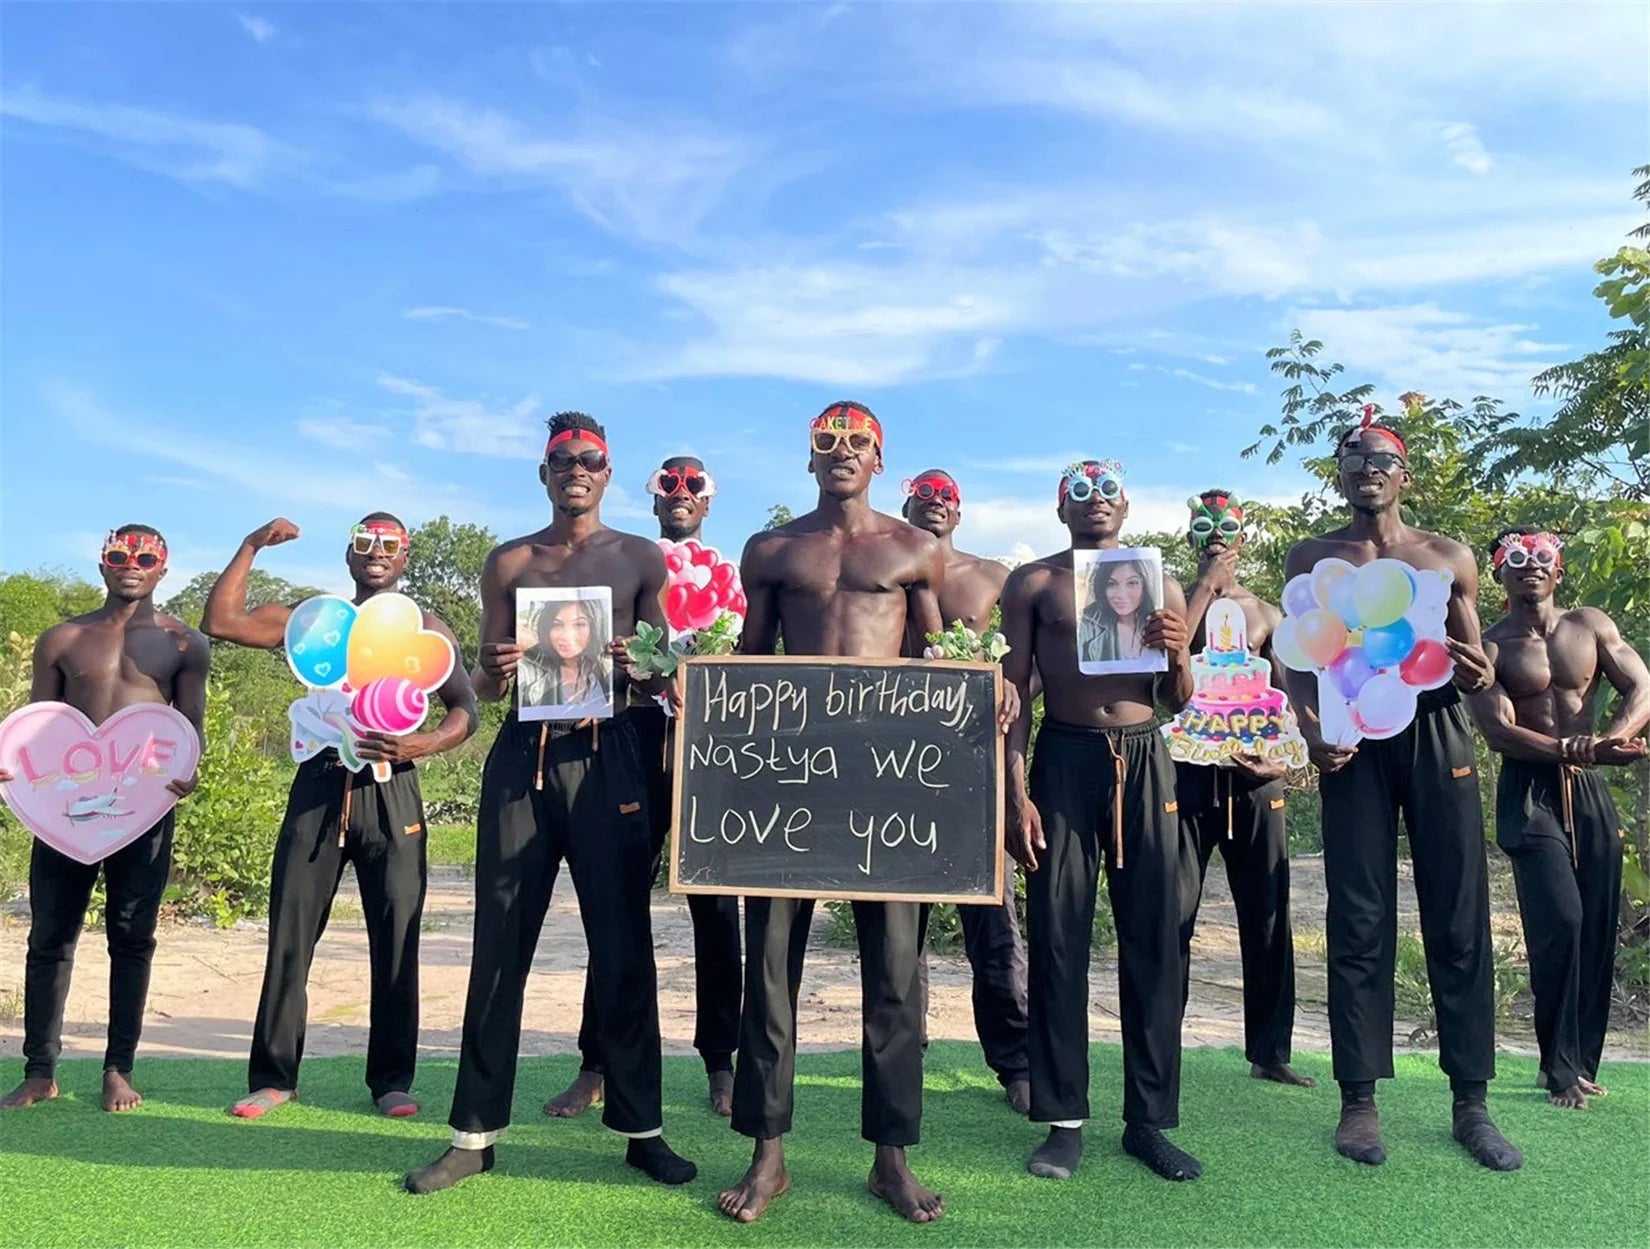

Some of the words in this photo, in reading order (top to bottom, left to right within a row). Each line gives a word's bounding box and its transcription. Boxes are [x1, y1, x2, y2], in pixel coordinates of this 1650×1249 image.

[703, 667, 808, 735] Happy
[1183, 711, 1289, 737] HAPPY
[17, 736, 177, 784] LOVE
[689, 734, 838, 784] Nastya
[689, 796, 812, 852] Love
[849, 810, 938, 876] you
